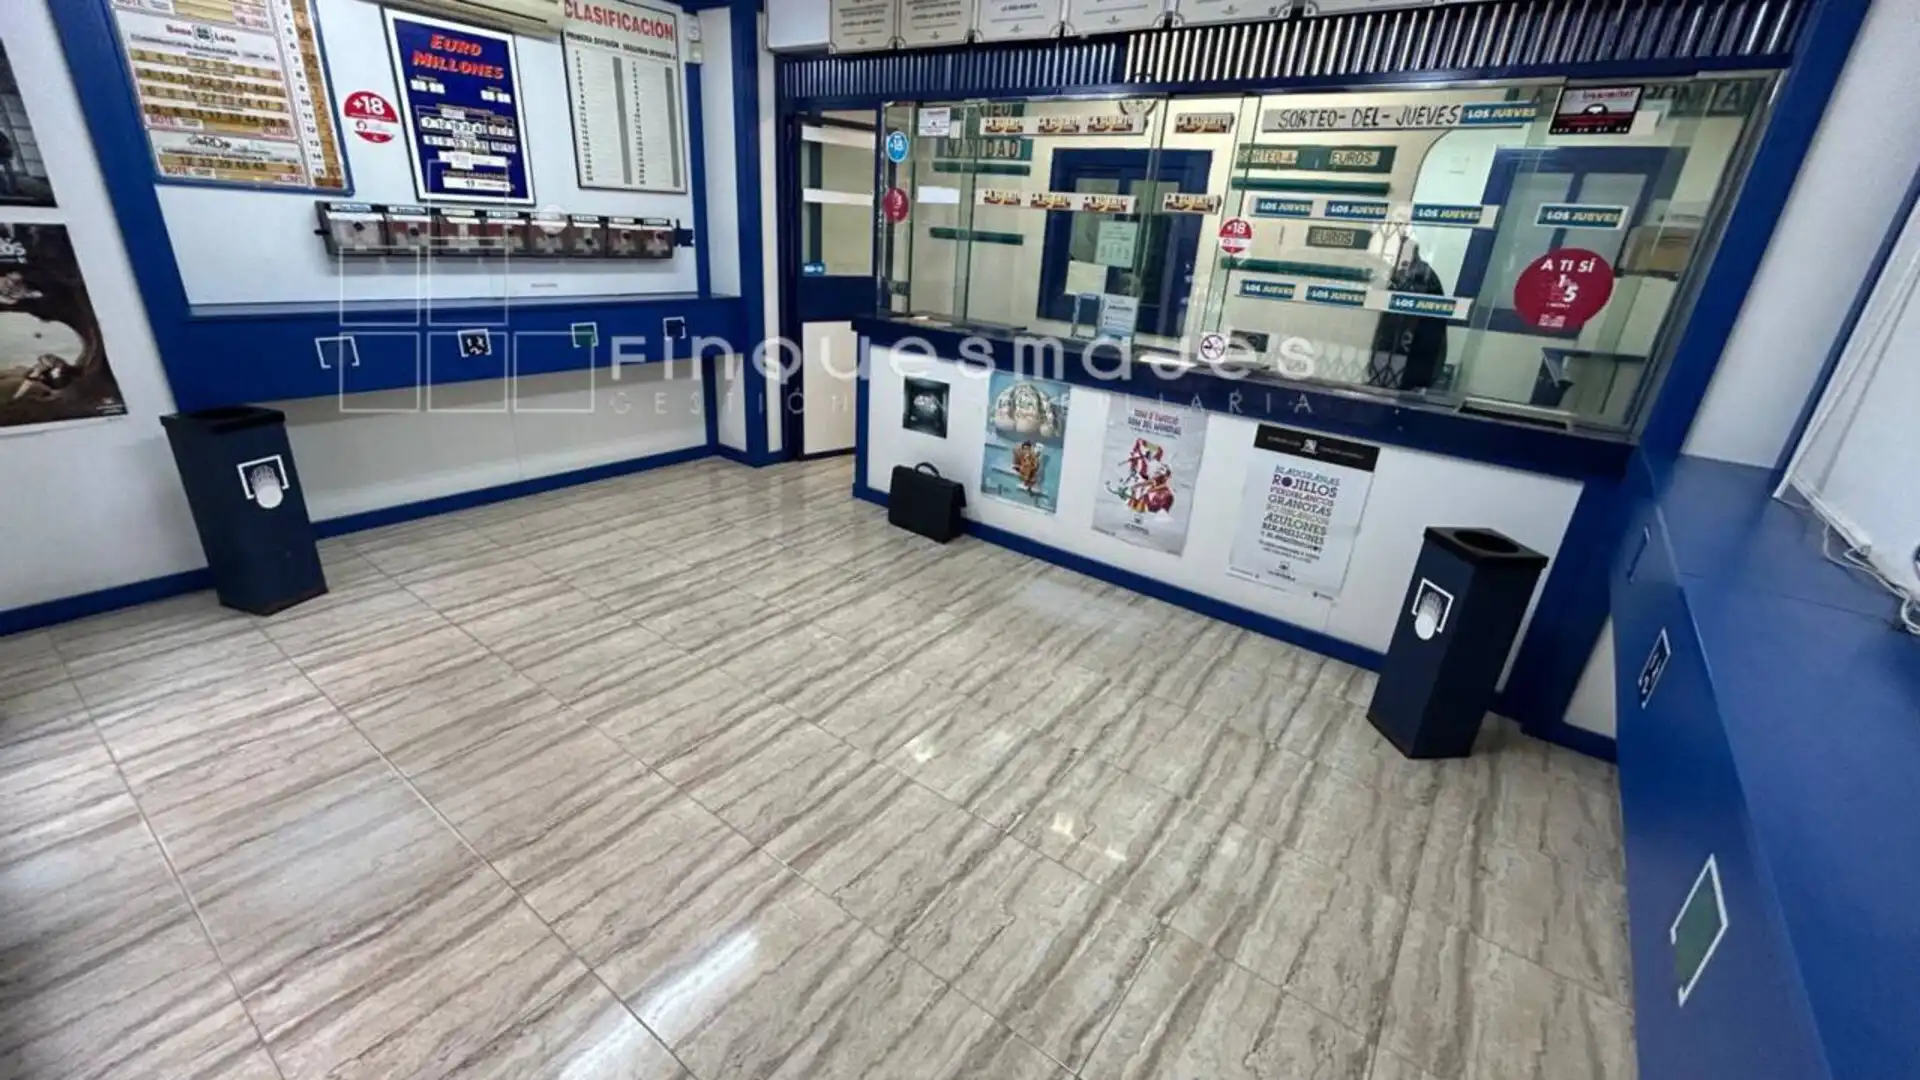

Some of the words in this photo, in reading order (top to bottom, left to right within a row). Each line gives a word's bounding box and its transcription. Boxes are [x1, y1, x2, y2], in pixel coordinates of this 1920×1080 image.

[431, 33, 482, 57] EURO
[412, 50, 504, 80] MILLONES
[352, 95, 386, 116] +18
[1468, 108, 1490, 119] LOS
[1492, 107, 1537, 118] JUEVES
[1396, 104, 1461, 127] JUEVES
[1332, 151, 1374, 166] EUROS
[1260, 201, 1278, 211] LOS
[1330, 203, 1350, 213] LOS
[1350, 204, 1386, 216] JUEVES
[1418, 208, 1438, 218] LOS
[1439, 209, 1480, 220] JUEVES
[1547, 210, 1569, 221] LOS
[1571, 211, 1620, 223] JUEVES
[1227, 222, 1246, 234] +18
[1540, 259, 1554, 271] A
[1560, 260, 1574, 272] TI
[1577, 257, 1597, 273] SÍ
[1245, 283, 1262, 292] LOS
[1262, 284, 1295, 296] JUEVES
[1312, 289, 1330, 299] LOS
[1330, 290, 1366, 303] JUEVES
[1395, 298, 1415, 308] LOS
[1416, 299, 1454, 312] JUEVES
[1272, 474, 1338, 499] ROJILLOS
[1267, 494, 1332, 517] GRANOTAS
[1263, 511, 1328, 537] AZULONES
[1261, 522, 1325, 546] BERMELLONES
